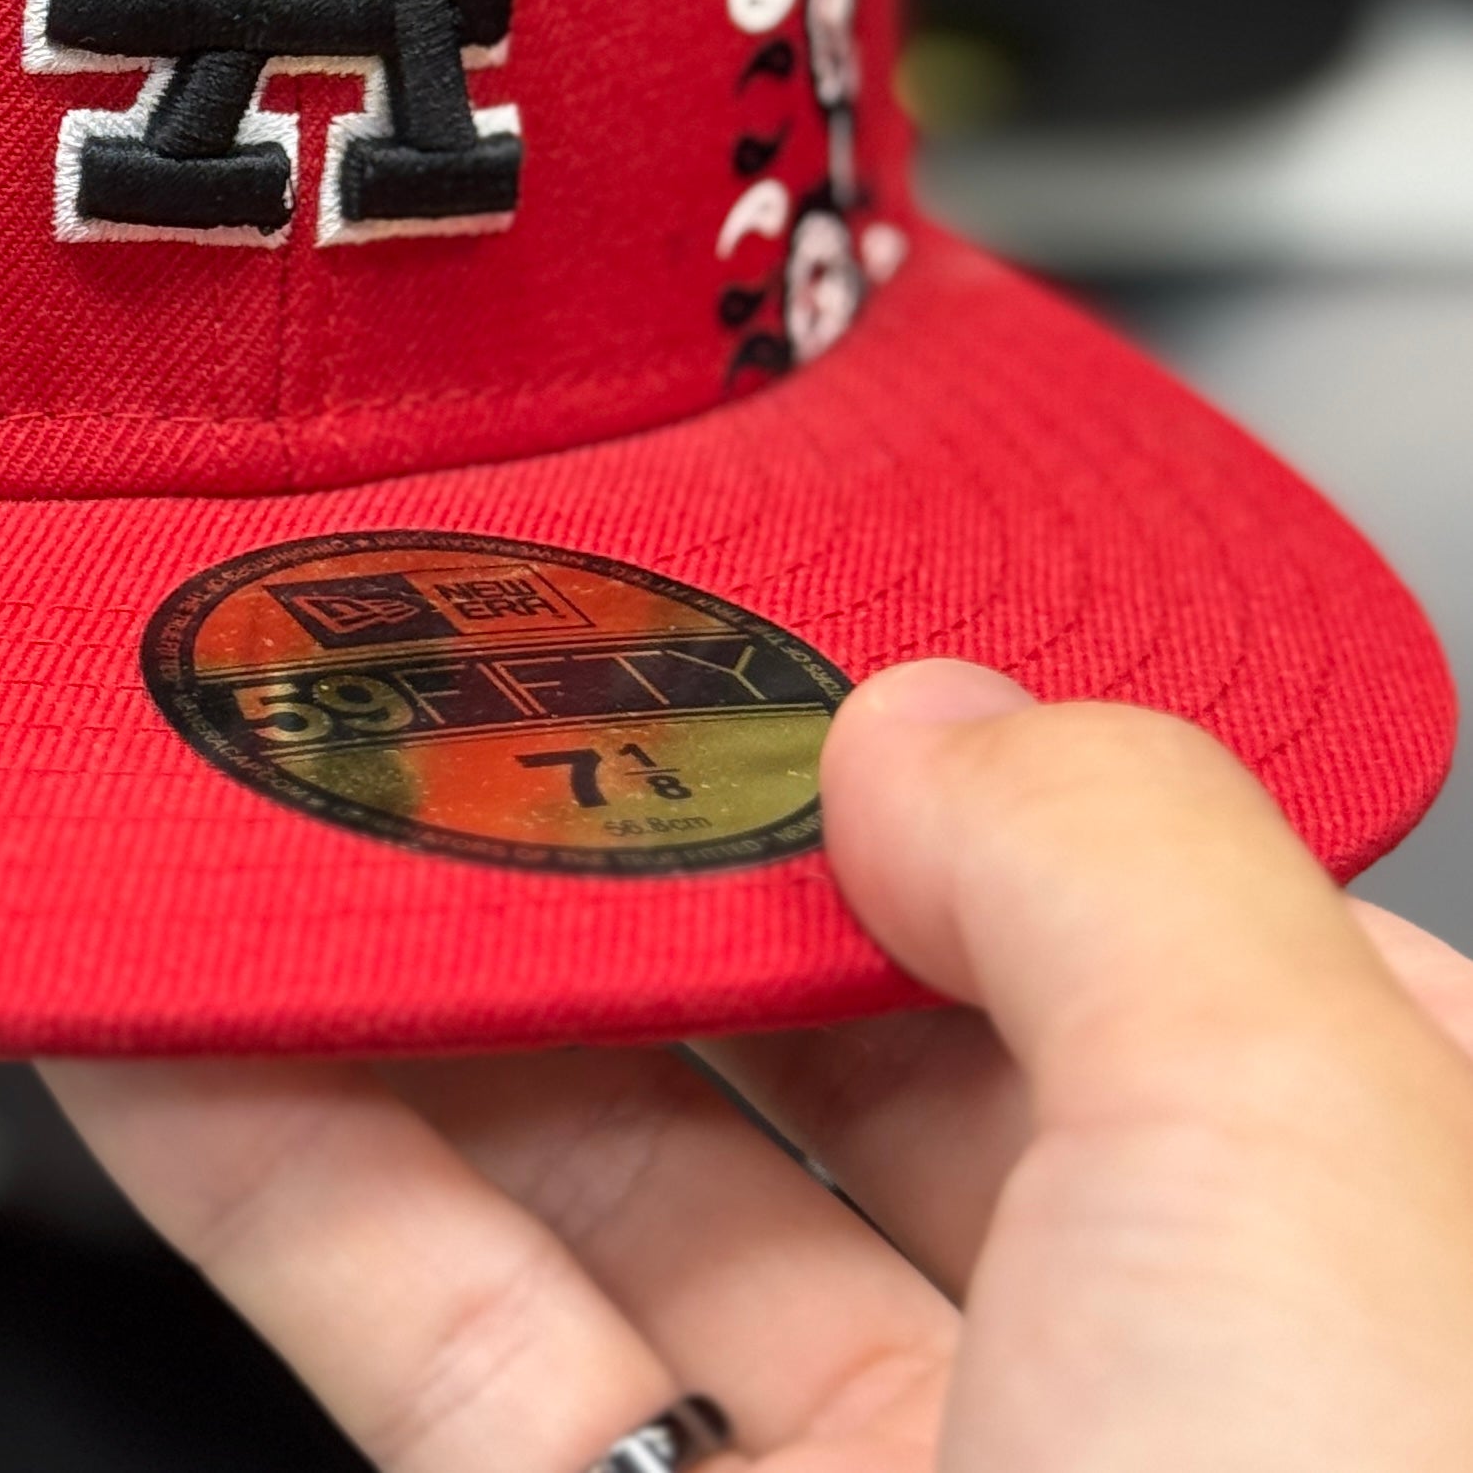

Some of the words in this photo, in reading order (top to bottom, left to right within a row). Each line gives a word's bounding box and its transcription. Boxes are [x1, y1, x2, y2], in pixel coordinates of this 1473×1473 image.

[433, 579, 538, 600] NEW
[454, 597, 558, 619] ERA
[234, 645, 767, 741] 59FIFTY
[515, 748, 608, 808] 7
